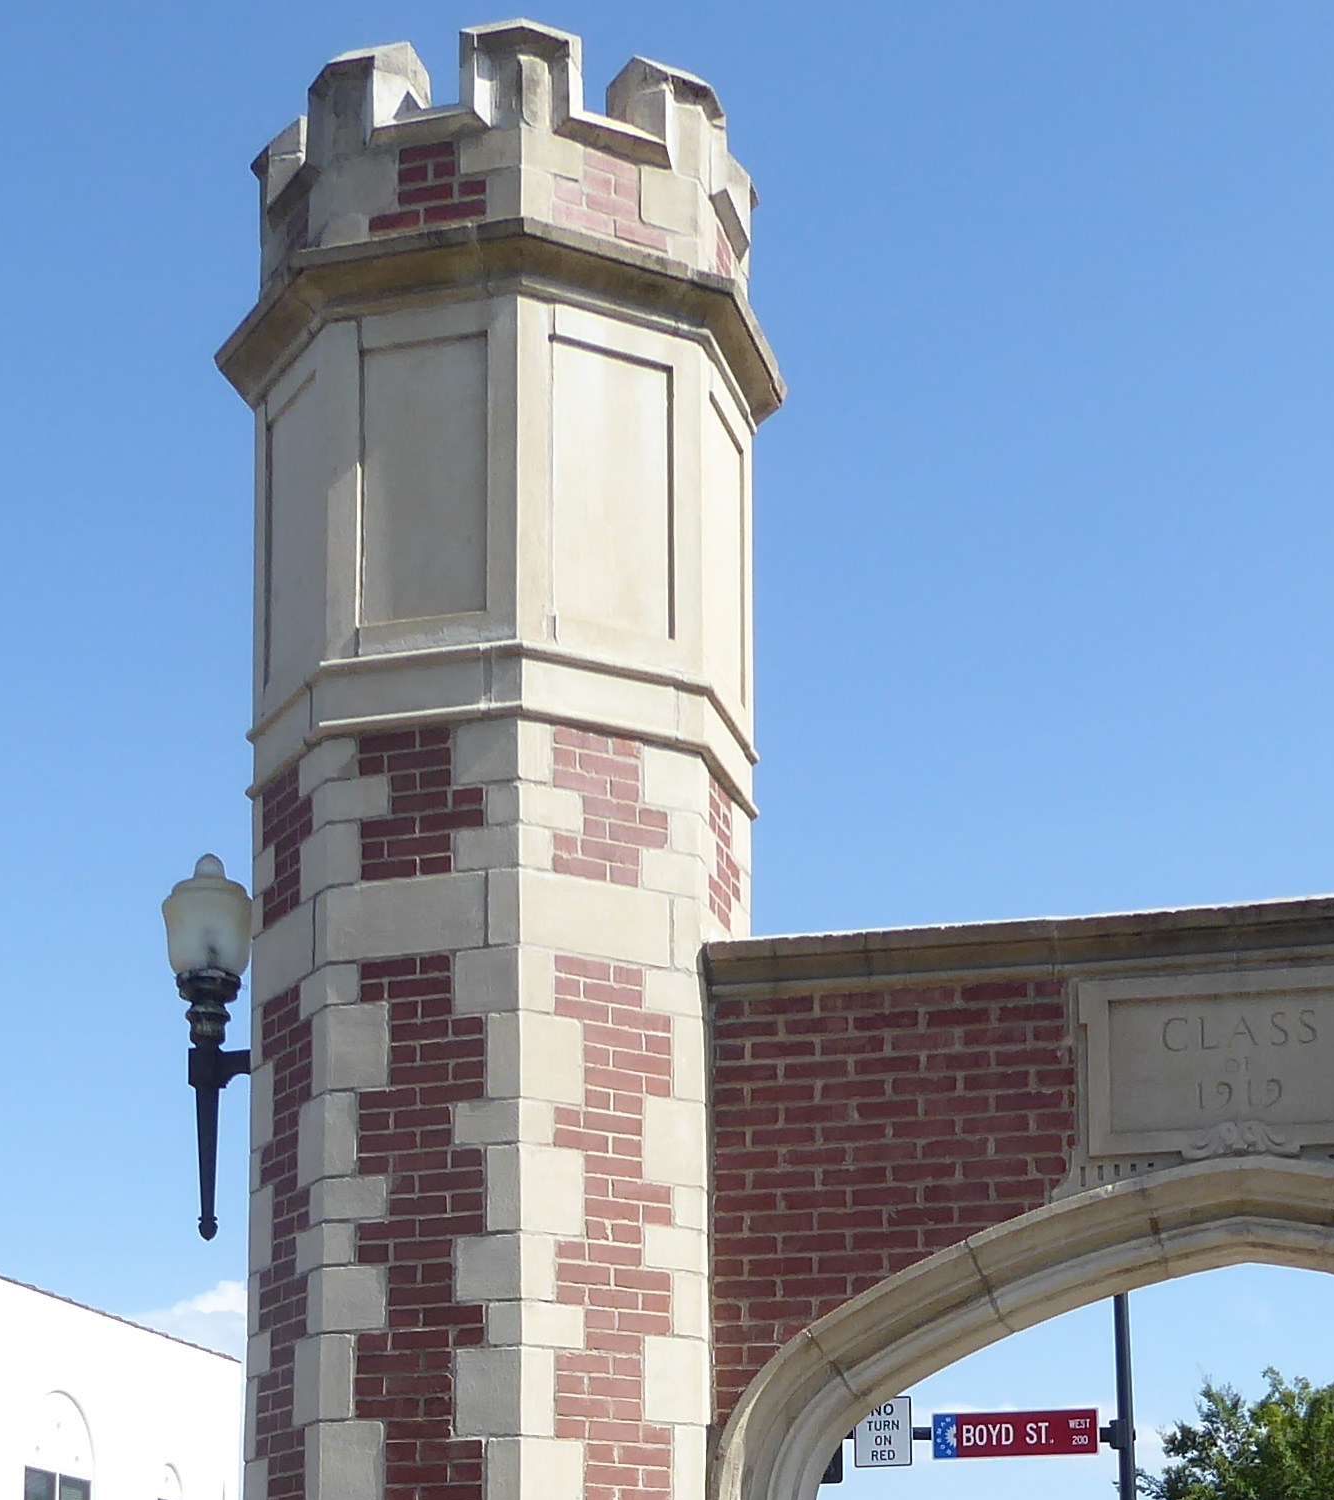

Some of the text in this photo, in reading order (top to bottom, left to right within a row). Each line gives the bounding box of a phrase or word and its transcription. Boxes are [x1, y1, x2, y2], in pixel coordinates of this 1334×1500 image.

[1162, 1009, 1317, 1052] CLASS
[1224, 1055, 1251, 1074] OF
[1196, 1078, 1283, 1111] 1919
[871, 1403, 894, 1417] NO
[866, 1420, 900, 1432] TURN
[1068, 1418, 1091, 1430] WEST
[962, 1421, 1056, 1447] BOYD ST.
[1071, 1435, 1089, 1446] 200
[874, 1435, 892, 1447] ON
[871, 1449, 896, 1462] RED
